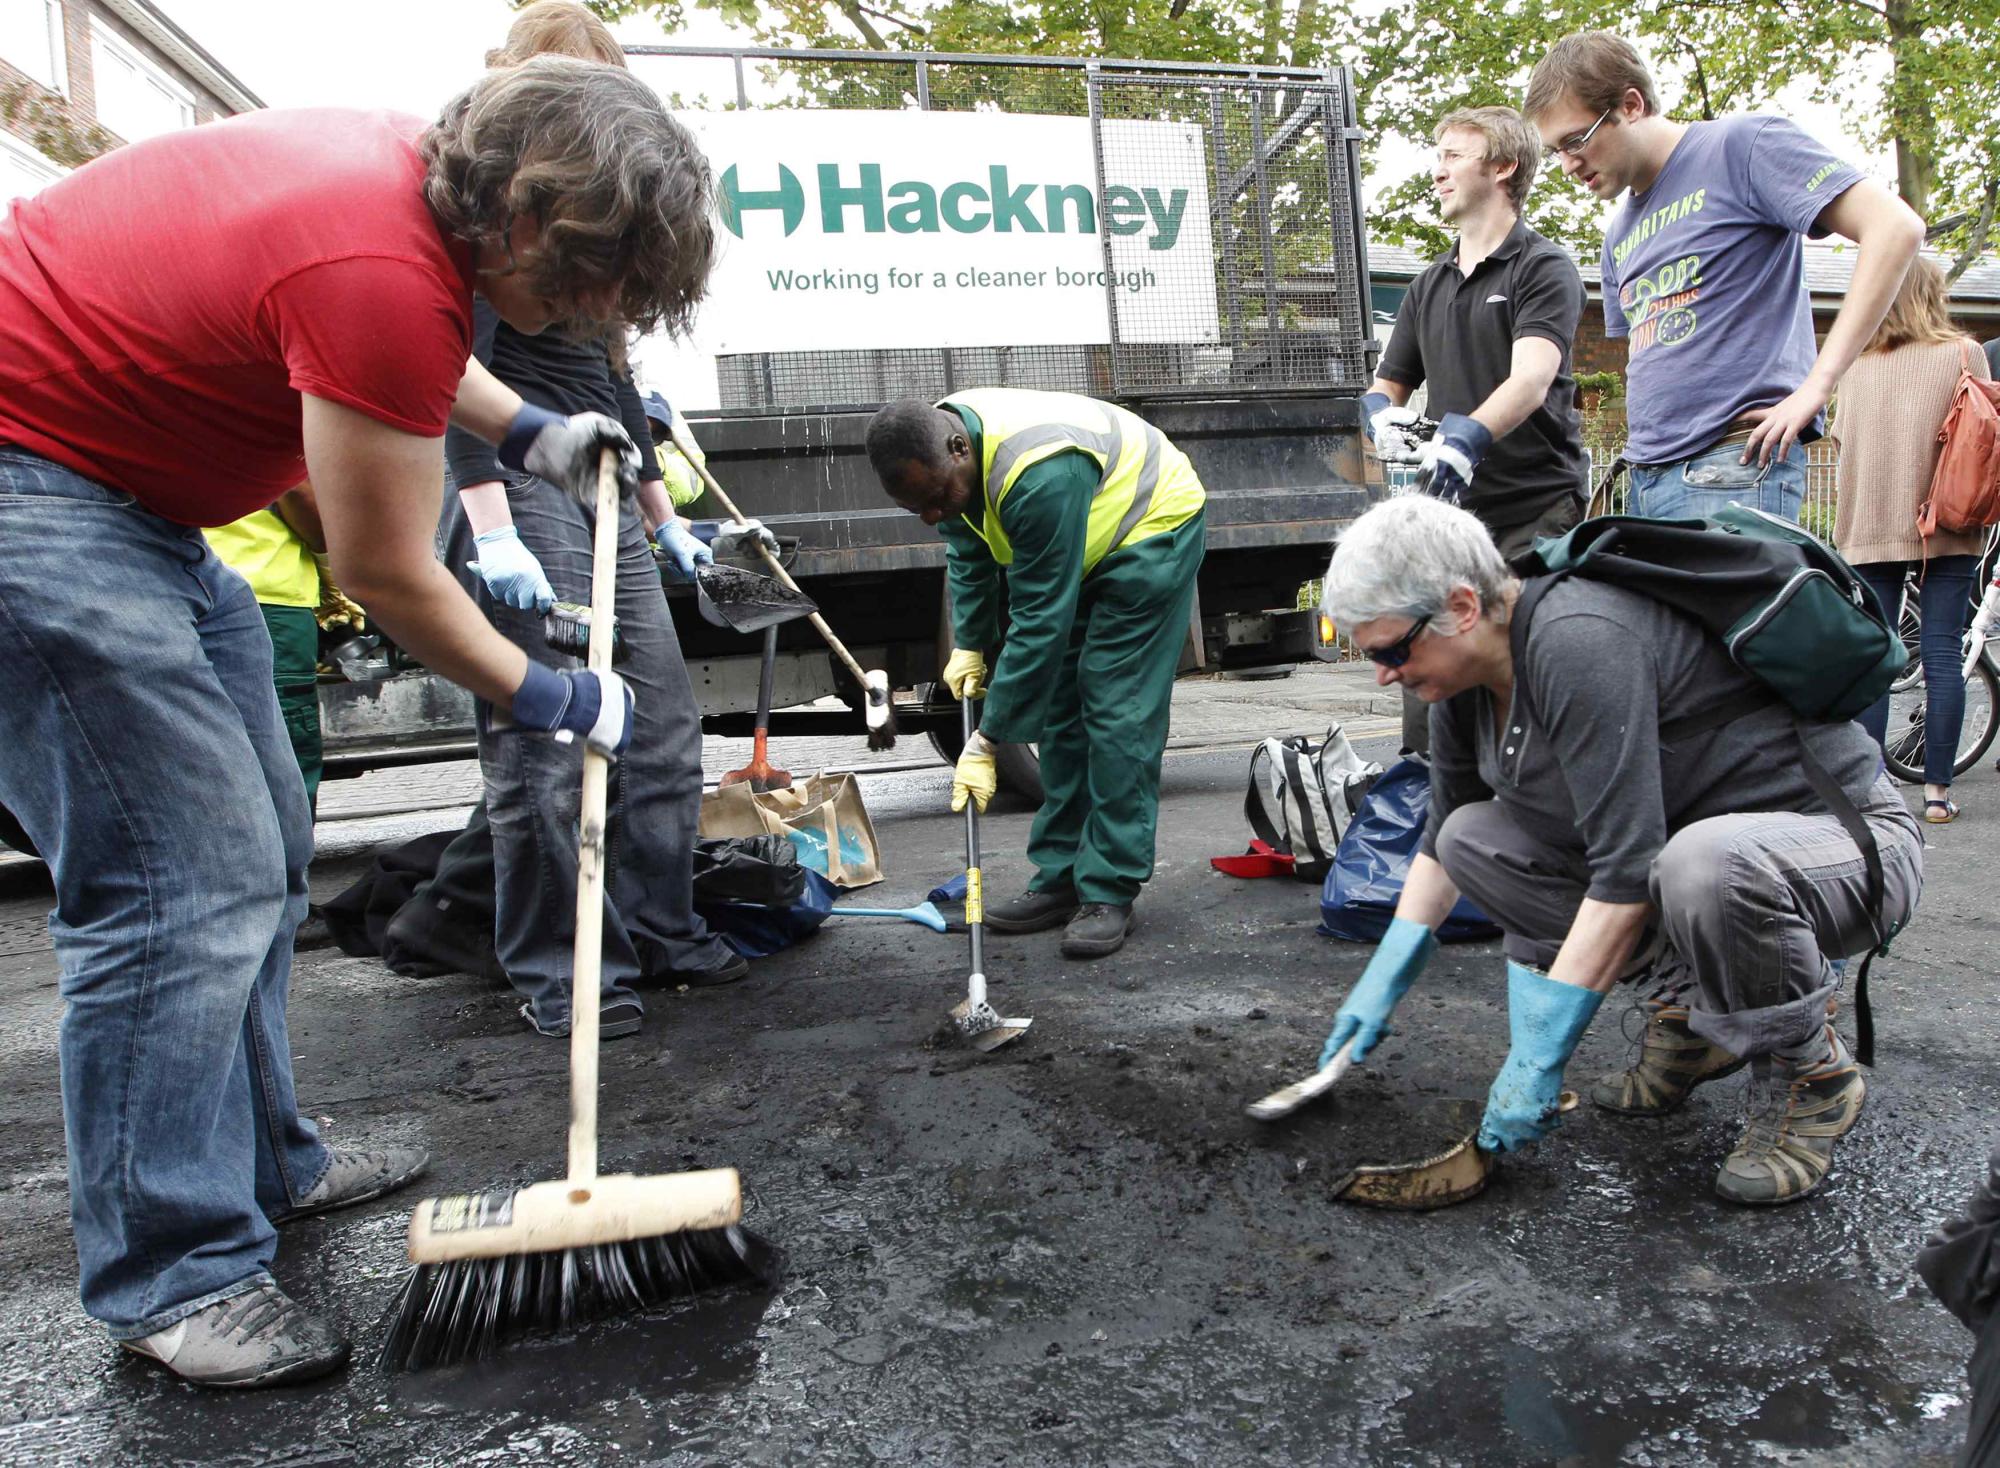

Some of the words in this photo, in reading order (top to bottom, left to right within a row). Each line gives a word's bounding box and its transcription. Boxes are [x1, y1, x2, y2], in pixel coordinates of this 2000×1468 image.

[817, 163, 1189, 251] Hackney
[1613, 188, 1706, 269] SAMARITANS
[766, 268, 879, 295] Working
[888, 267, 924, 288] for
[933, 271, 947, 288] a
[955, 266, 1047, 288] cleaner
[1055, 266, 1157, 293] borough
